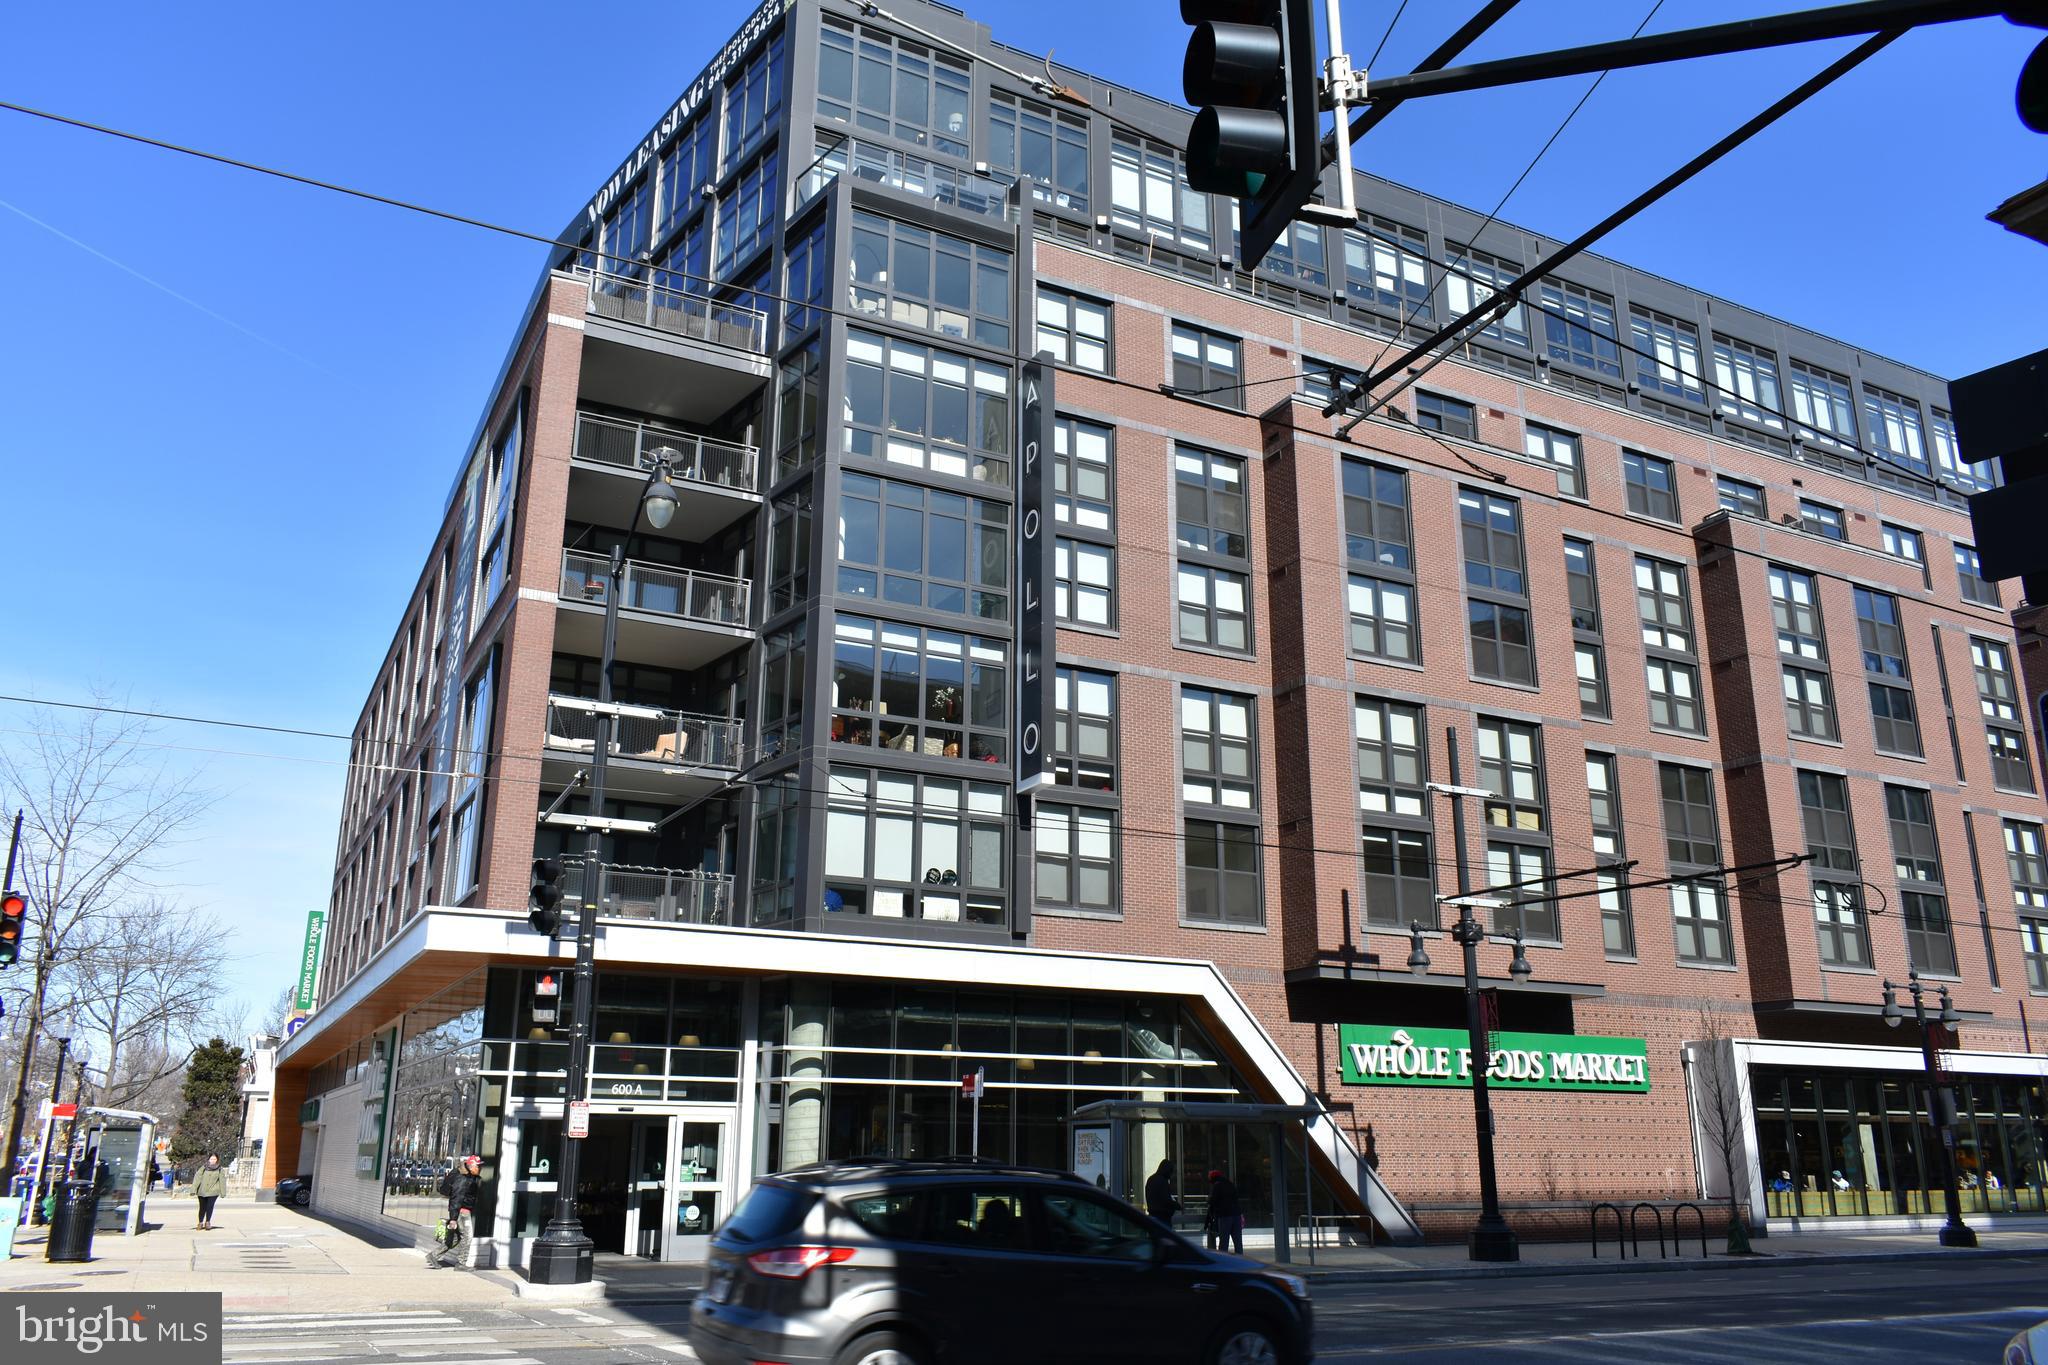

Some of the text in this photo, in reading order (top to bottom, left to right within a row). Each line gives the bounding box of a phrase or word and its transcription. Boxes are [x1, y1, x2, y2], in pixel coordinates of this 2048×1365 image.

[587, 76, 706, 227] NOW LEASING
[1023, 379, 1041, 756] APOLLO
[301, 917, 321, 1003] WHOLE FOODS MARKET
[611, 1083, 643, 1095] 600 A
[1349, 1031, 1453, 1077] WHOLE
[1548, 1051, 1647, 1083] MARKET
